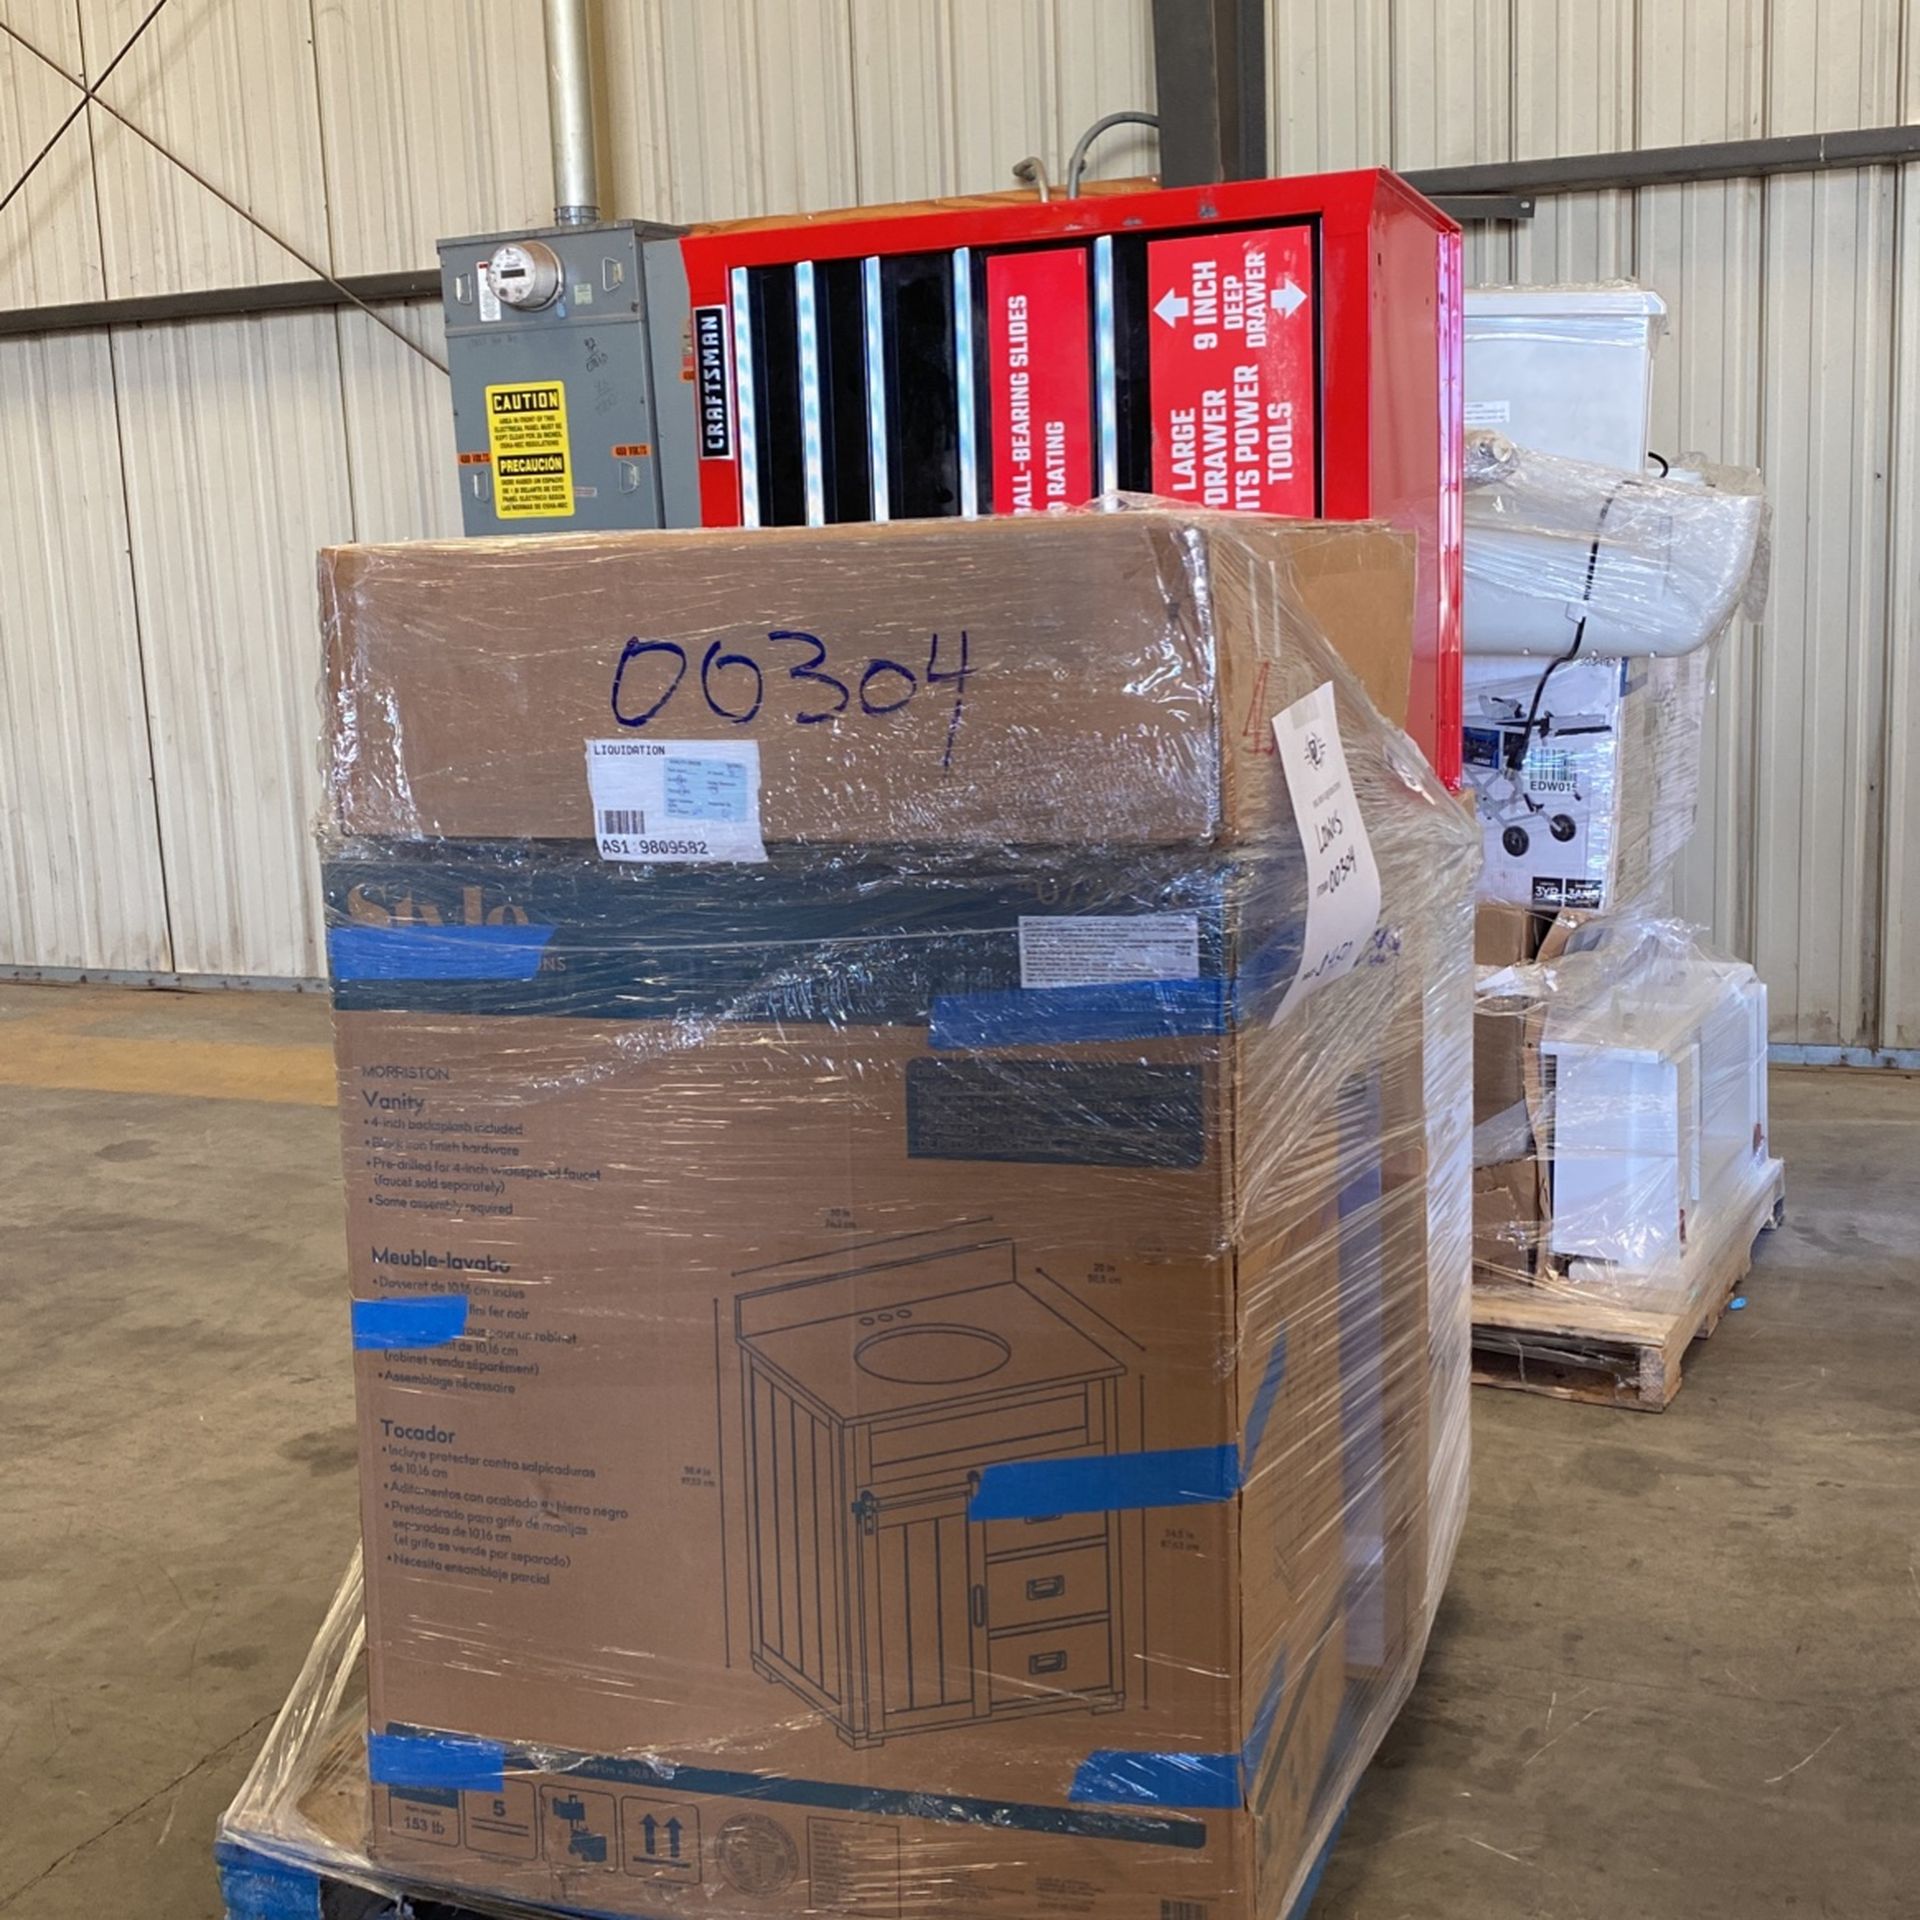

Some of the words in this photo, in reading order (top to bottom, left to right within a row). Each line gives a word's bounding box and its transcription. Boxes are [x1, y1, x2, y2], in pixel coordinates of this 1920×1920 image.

[1192, 261, 1217, 325] INCH
[1223, 275, 1244, 331] DEEP
[1245, 252, 1266, 348] DRAWER
[1008, 295, 1028, 366] SLIDES
[1193, 333, 1218, 349] 9
[701, 315, 724, 449] CRAFTSMAN
[493, 391, 558, 411] CAUTION
[1234, 364, 1260, 462] POWER
[1171, 408, 1196, 491] LARGE
[1202, 388, 1228, 505] DRAWER
[1267, 402, 1293, 485] TOOLS
[500, 455, 562, 473] PRECAUCIÓN
[1046, 422, 1065, 496] RATING
[611, 629, 979, 773] 00304
[594, 746, 665, 755] LIQUIDATION
[602, 840, 630, 853] AS1
[639, 840, 708, 854] 9809582
[362, 1065, 449, 1081] MORRISTON
[362, 1090, 424, 1115] Vanity
[371, 1117, 405, 1130] 4-inch
[475, 1123, 523, 1136] included
[462, 1142, 519, 1157] hardware
[373, 1158, 432, 1173] Pre-drilled
[434, 1160, 450, 1173] for
[453, 1162, 489, 1175] 4-inch
[415, 1175, 438, 1188] sold
[441, 1179, 505, 1196] separately)
[375, 1194, 408, 1208] Some
[371, 1247, 511, 1273] Meuble-lavabo
[431, 1279, 445, 1291] de
[474, 1286, 490, 1297] cm
[493, 1286, 525, 1299] inclus
[488, 1306, 504, 1319] fer
[506, 1308, 530, 1320] noir
[458, 1342, 472, 1354] de
[502, 1347, 518, 1357] cm
[429, 1356, 464, 1369] vendu
[384, 1370, 454, 1390] Assemblage
[380, 1419, 455, 1444] Tocador
[390, 1462, 404, 1474] de
[431, 1468, 448, 1479] cm
[483, 1458, 519, 1471] contra
[521, 1461, 596, 1479] salpicaduras
[463, 1491, 484, 1503] con
[486, 1494, 537, 1509] acabado
[593, 1506, 628, 1521] negro
[467, 1511, 494, 1525] para
[525, 1517, 539, 1529] de
[452, 1526, 466, 1538] de
[495, 1533, 512, 1543] cm
[394, 1533, 409, 1547] (el
[410, 1535, 436, 1551] grifo
[438, 1541, 450, 1552] se
[452, 1543, 487, 1558] vende
[489, 1548, 508, 1561] por
[511, 1551, 571, 1568] separado)
[394, 1553, 442, 1571] Necesita
[444, 1561, 509, 1582] ensamblaje
[511, 1571, 550, 1585] parcial
[493, 1800, 506, 1817] 5
[404, 1816, 427, 1831] 153
[432, 1821, 445, 1835] lb
